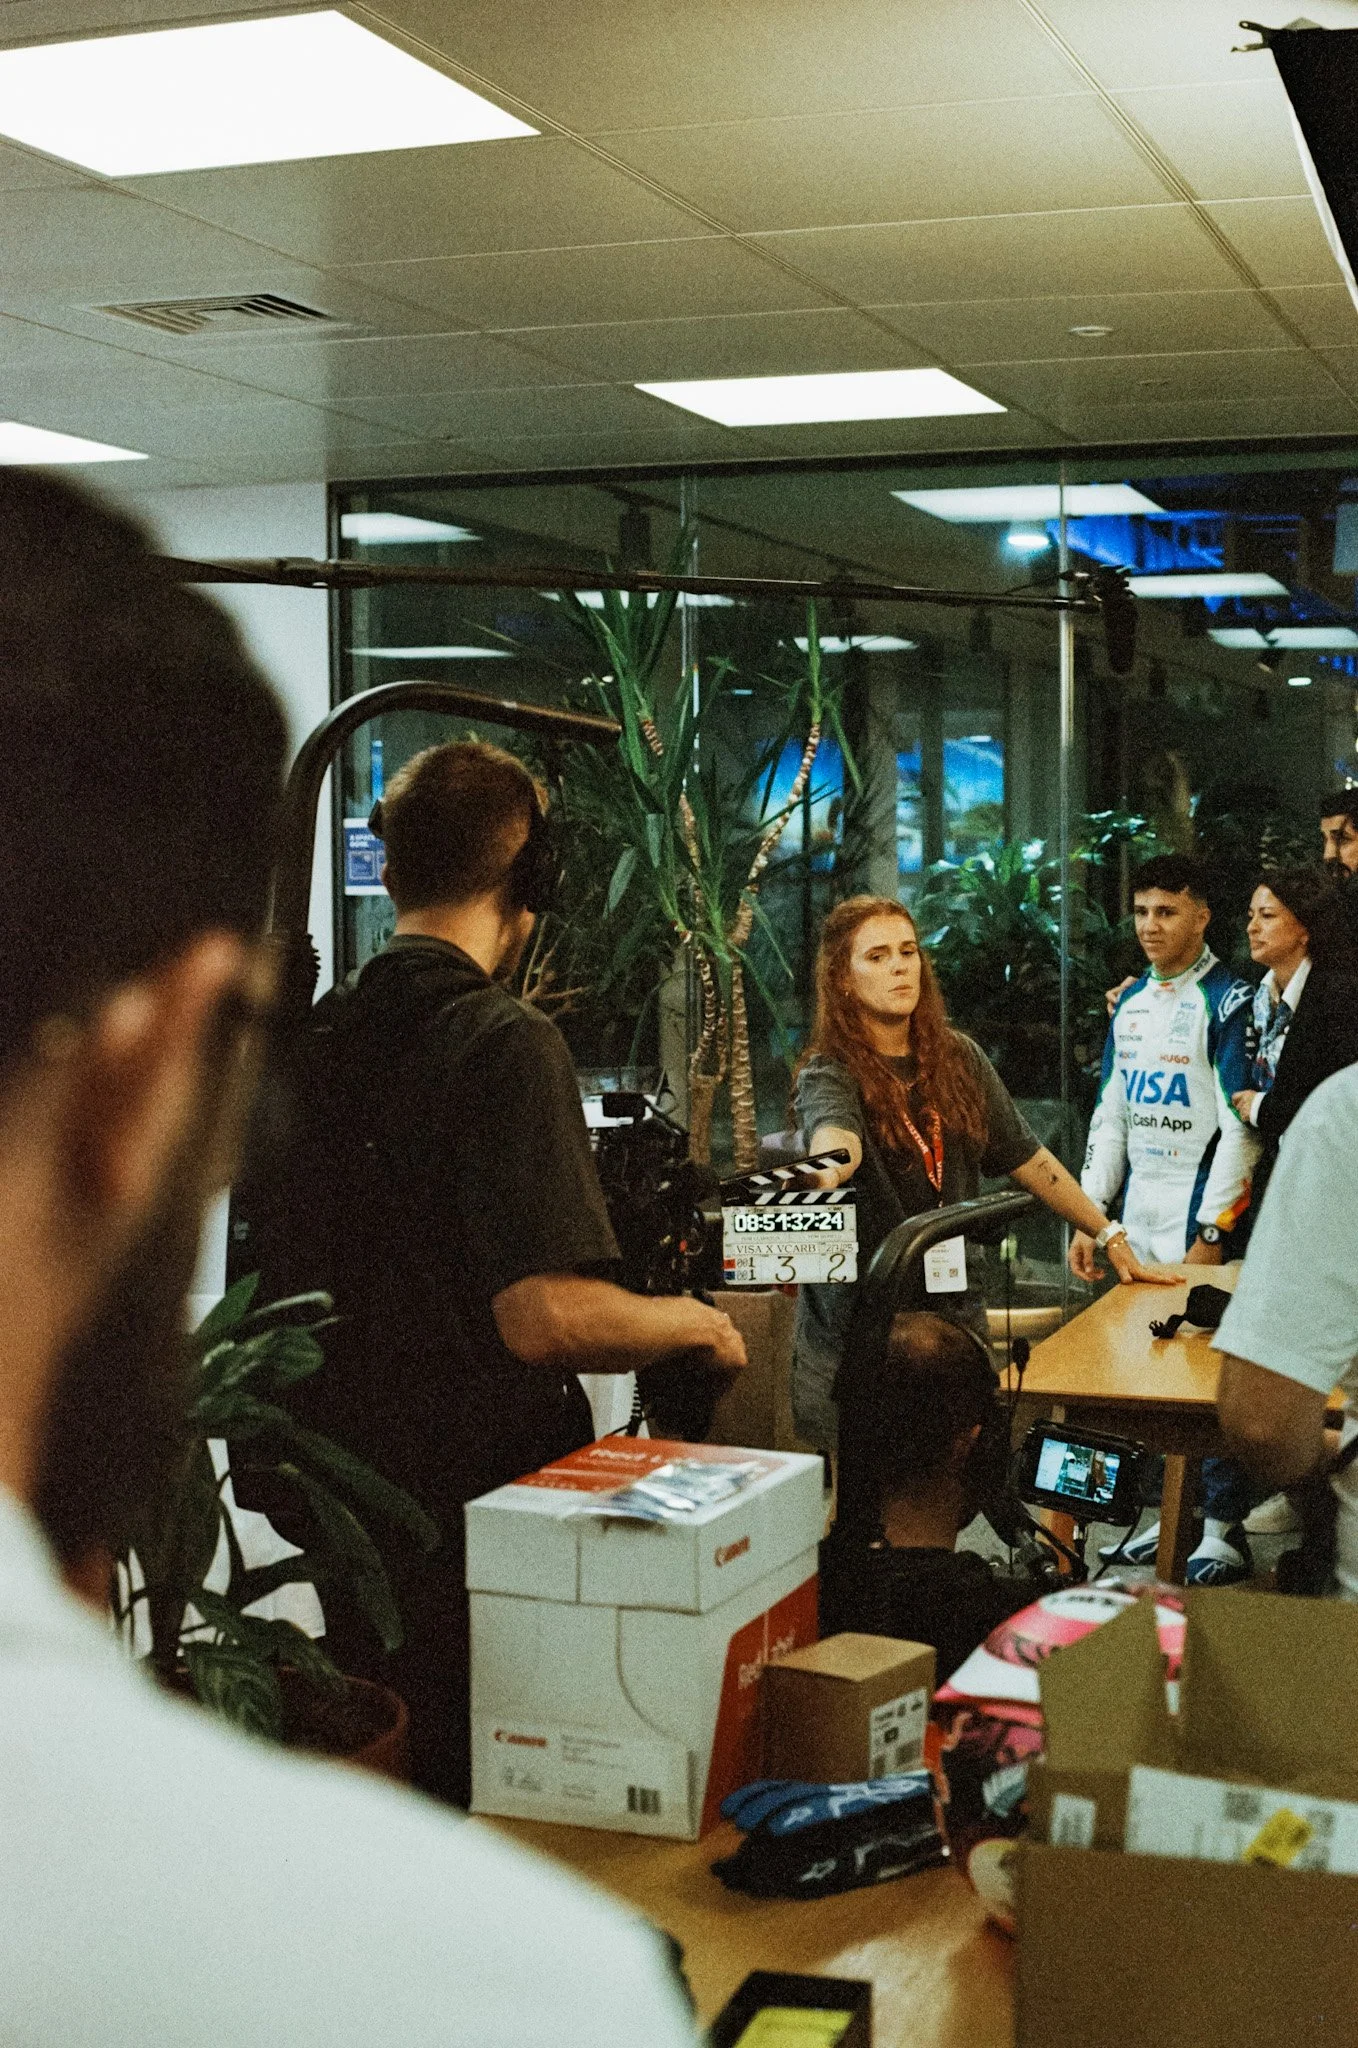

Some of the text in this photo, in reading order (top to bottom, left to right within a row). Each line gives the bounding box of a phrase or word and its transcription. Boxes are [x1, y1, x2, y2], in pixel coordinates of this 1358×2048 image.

[1160, 1054, 1190, 1065] HUGO
[1120, 1069, 1191, 1108] VISA
[1132, 1112, 1192, 1132] Cash App
[735, 1212, 843, 1232] 08:51:37:24
[736, 1243, 817, 1254] VISA X VCARB
[775, 1255, 796, 1283] 3
[827, 1253, 847, 1283] 2
